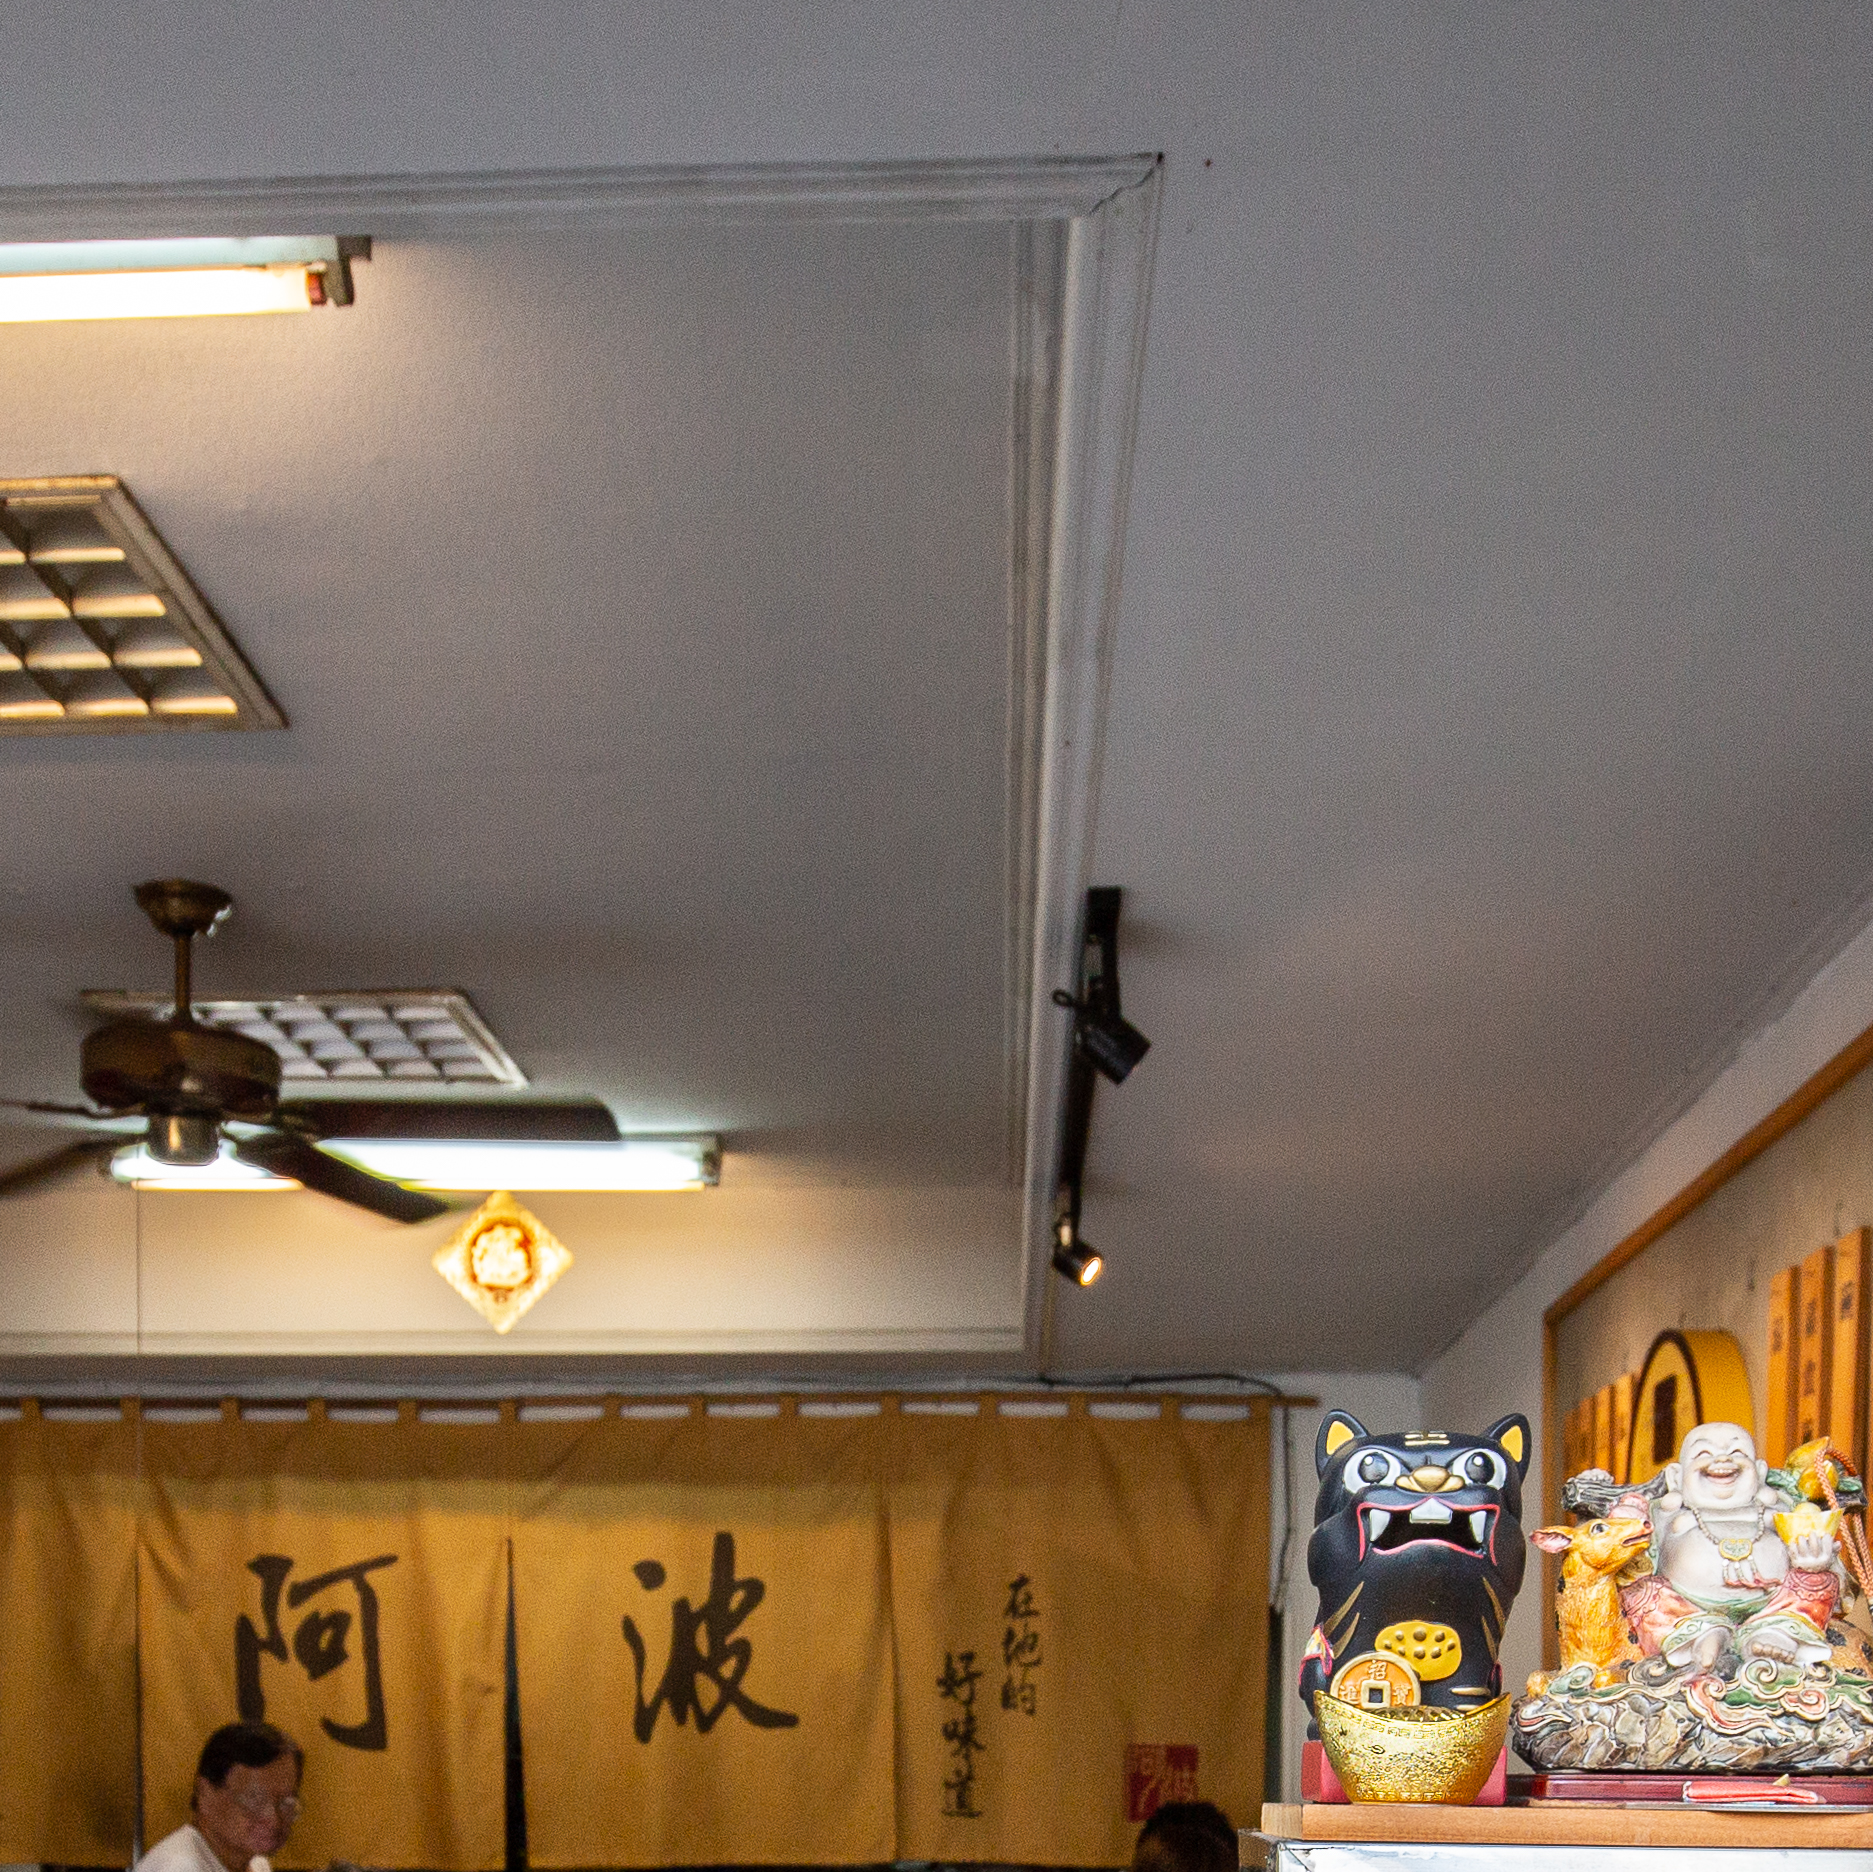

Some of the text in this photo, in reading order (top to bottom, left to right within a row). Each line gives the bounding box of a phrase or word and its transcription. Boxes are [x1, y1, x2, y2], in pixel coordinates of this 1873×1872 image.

[1000, 1573, 1042, 1717] 在地的
[935, 1650, 987, 1820] 好味道
